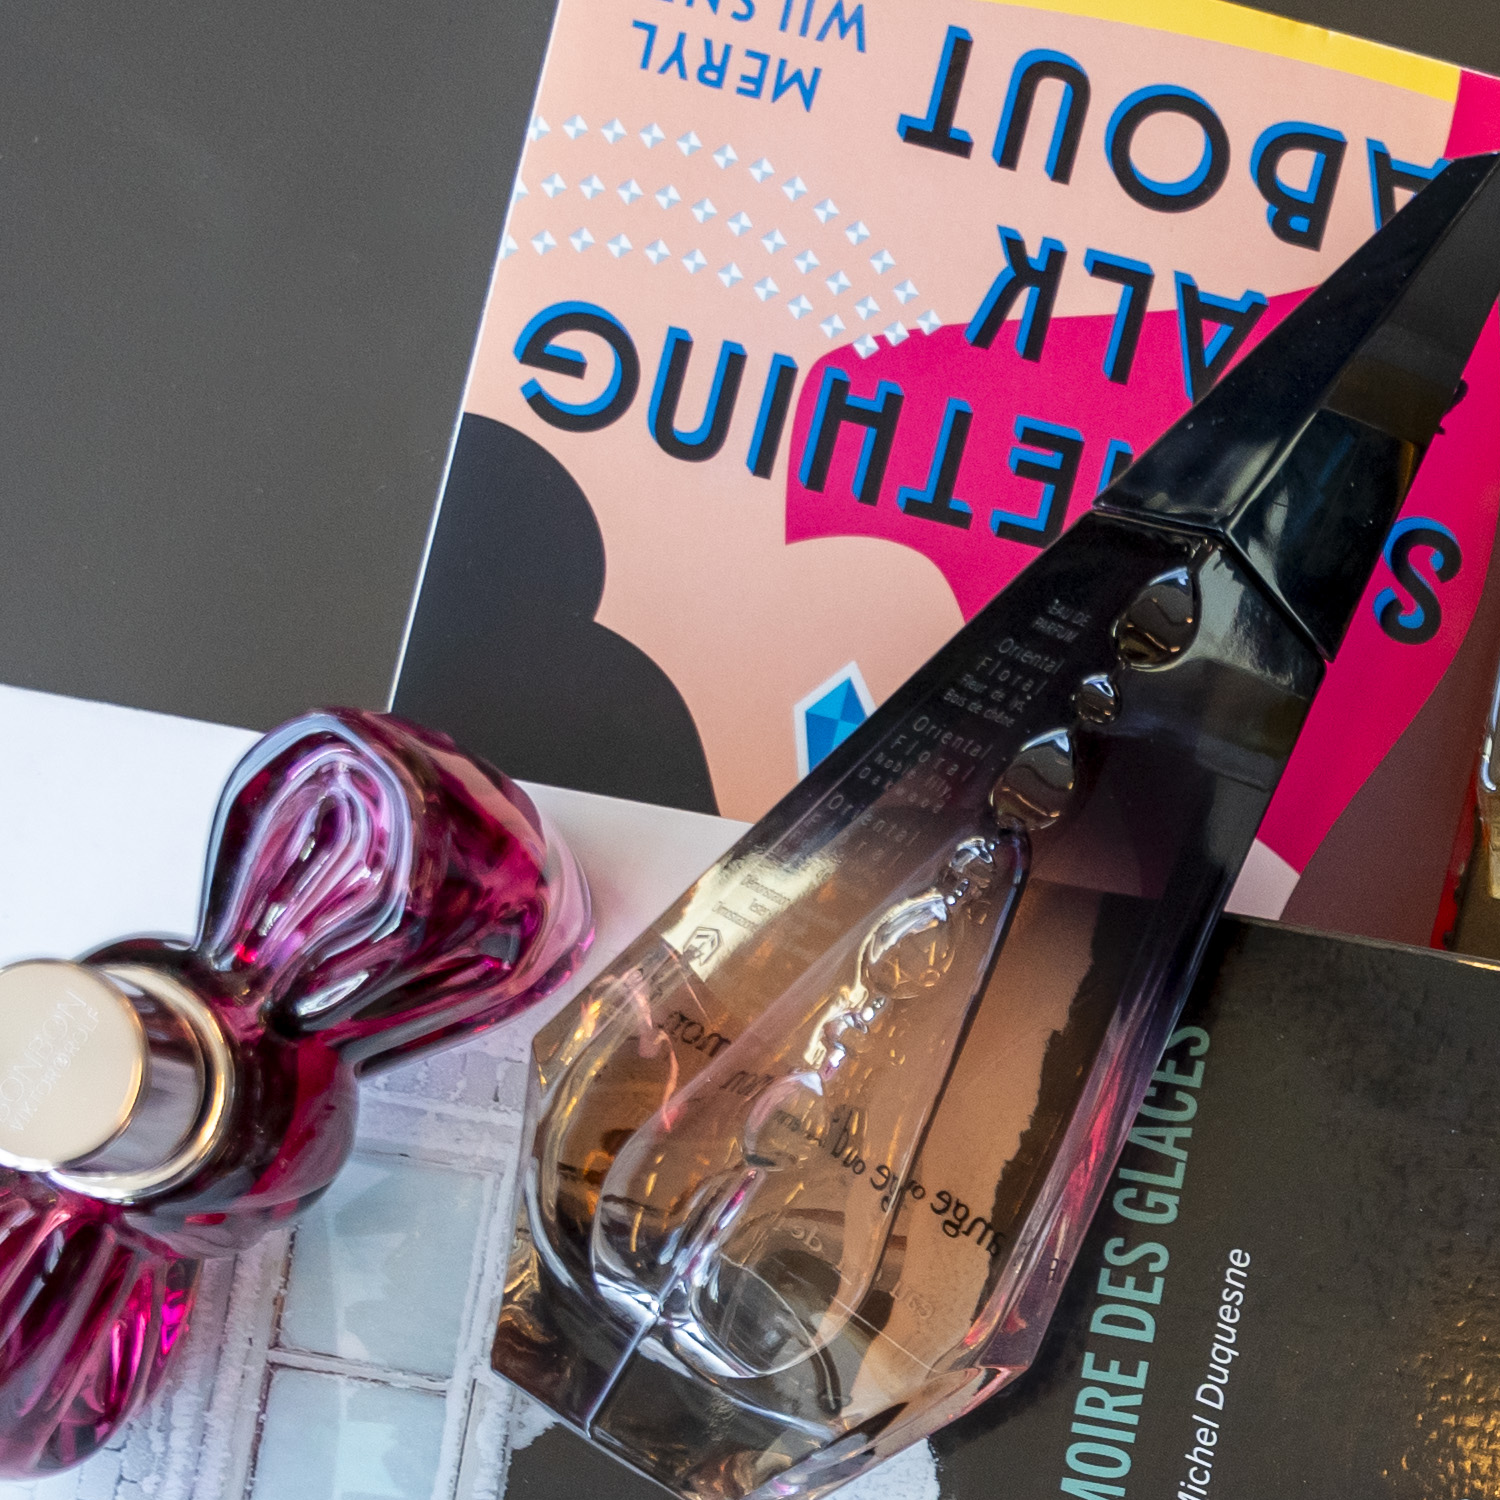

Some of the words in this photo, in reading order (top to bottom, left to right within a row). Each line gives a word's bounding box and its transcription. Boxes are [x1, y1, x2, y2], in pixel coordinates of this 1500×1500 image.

[631, 19, 822, 112] MERYL
[965, 225, 1268, 402] ALK
[1113, 1024, 1210, 1225] GLACES
[1090, 1234, 1170, 1344] DES
[1196, 1247, 1252, 1413] Duquesne
